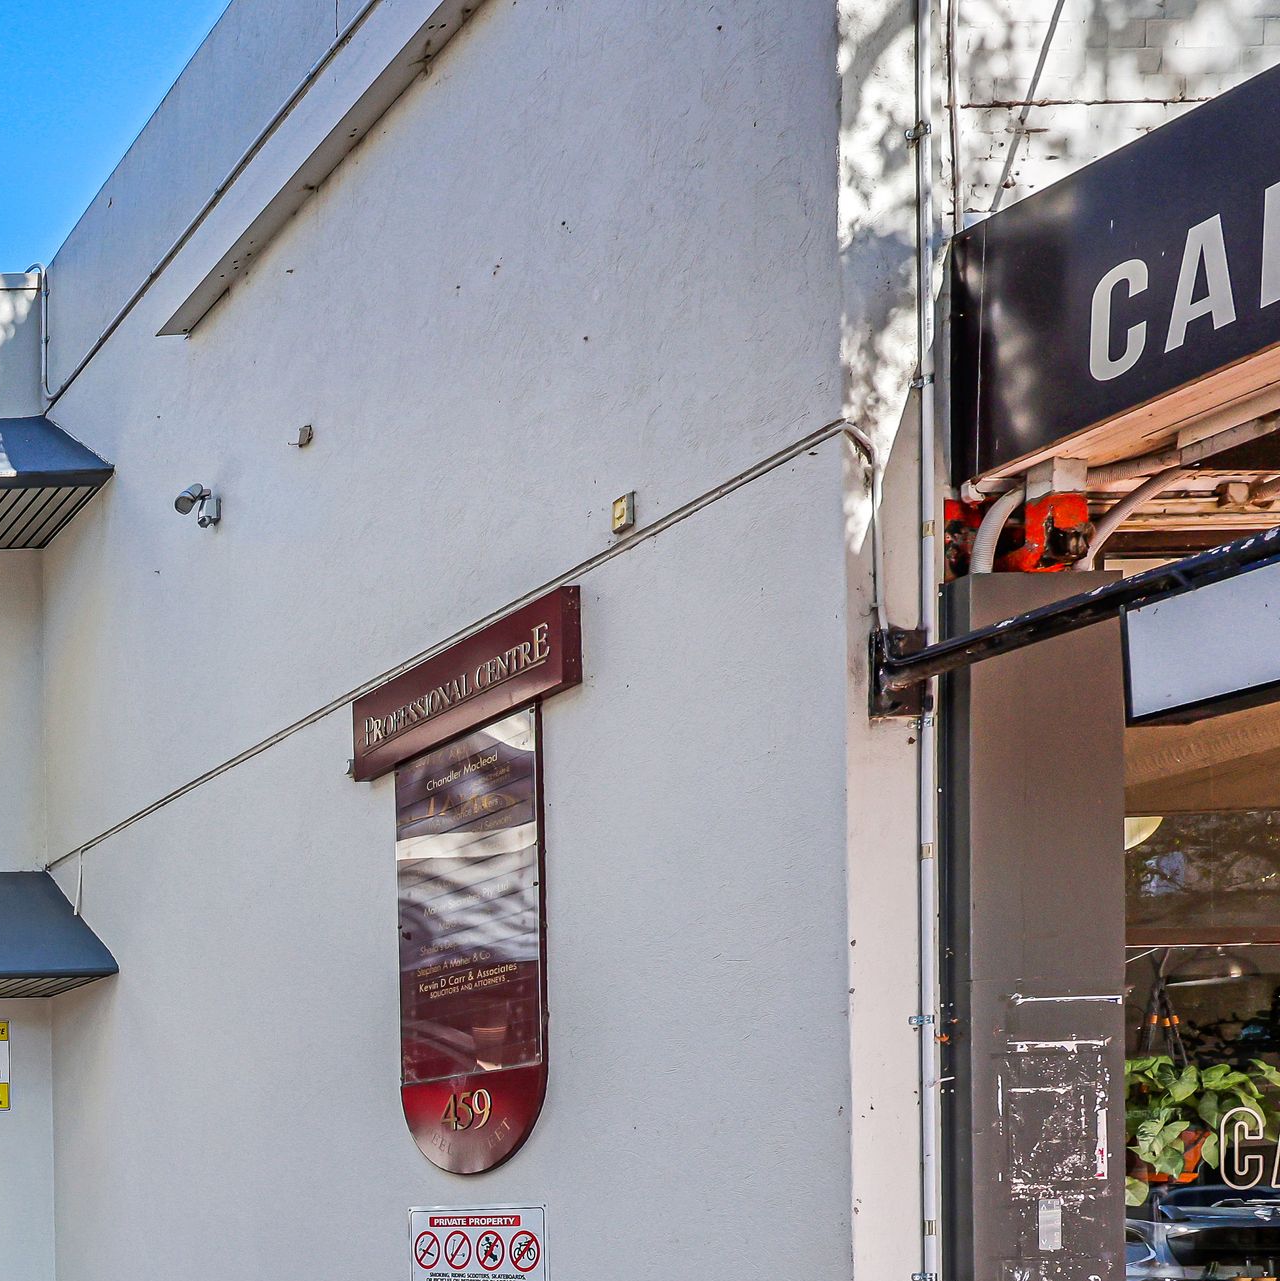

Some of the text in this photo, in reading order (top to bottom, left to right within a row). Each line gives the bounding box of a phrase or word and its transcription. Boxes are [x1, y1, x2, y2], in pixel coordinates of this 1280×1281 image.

[363, 622, 550, 747] PROFESSIONAL CENTRE
[426, 769, 462, 791] Chandler
[463, 750, 498, 776] Macleod
[419, 962, 518, 993] Kevin D Carr & Associates
[460, 982, 473, 991] AND
[440, 1088, 492, 1131] 459
[1220, 1106, 1280, 1191] C
[434, 1217, 515, 1226] PRIVATE PROPERTY
